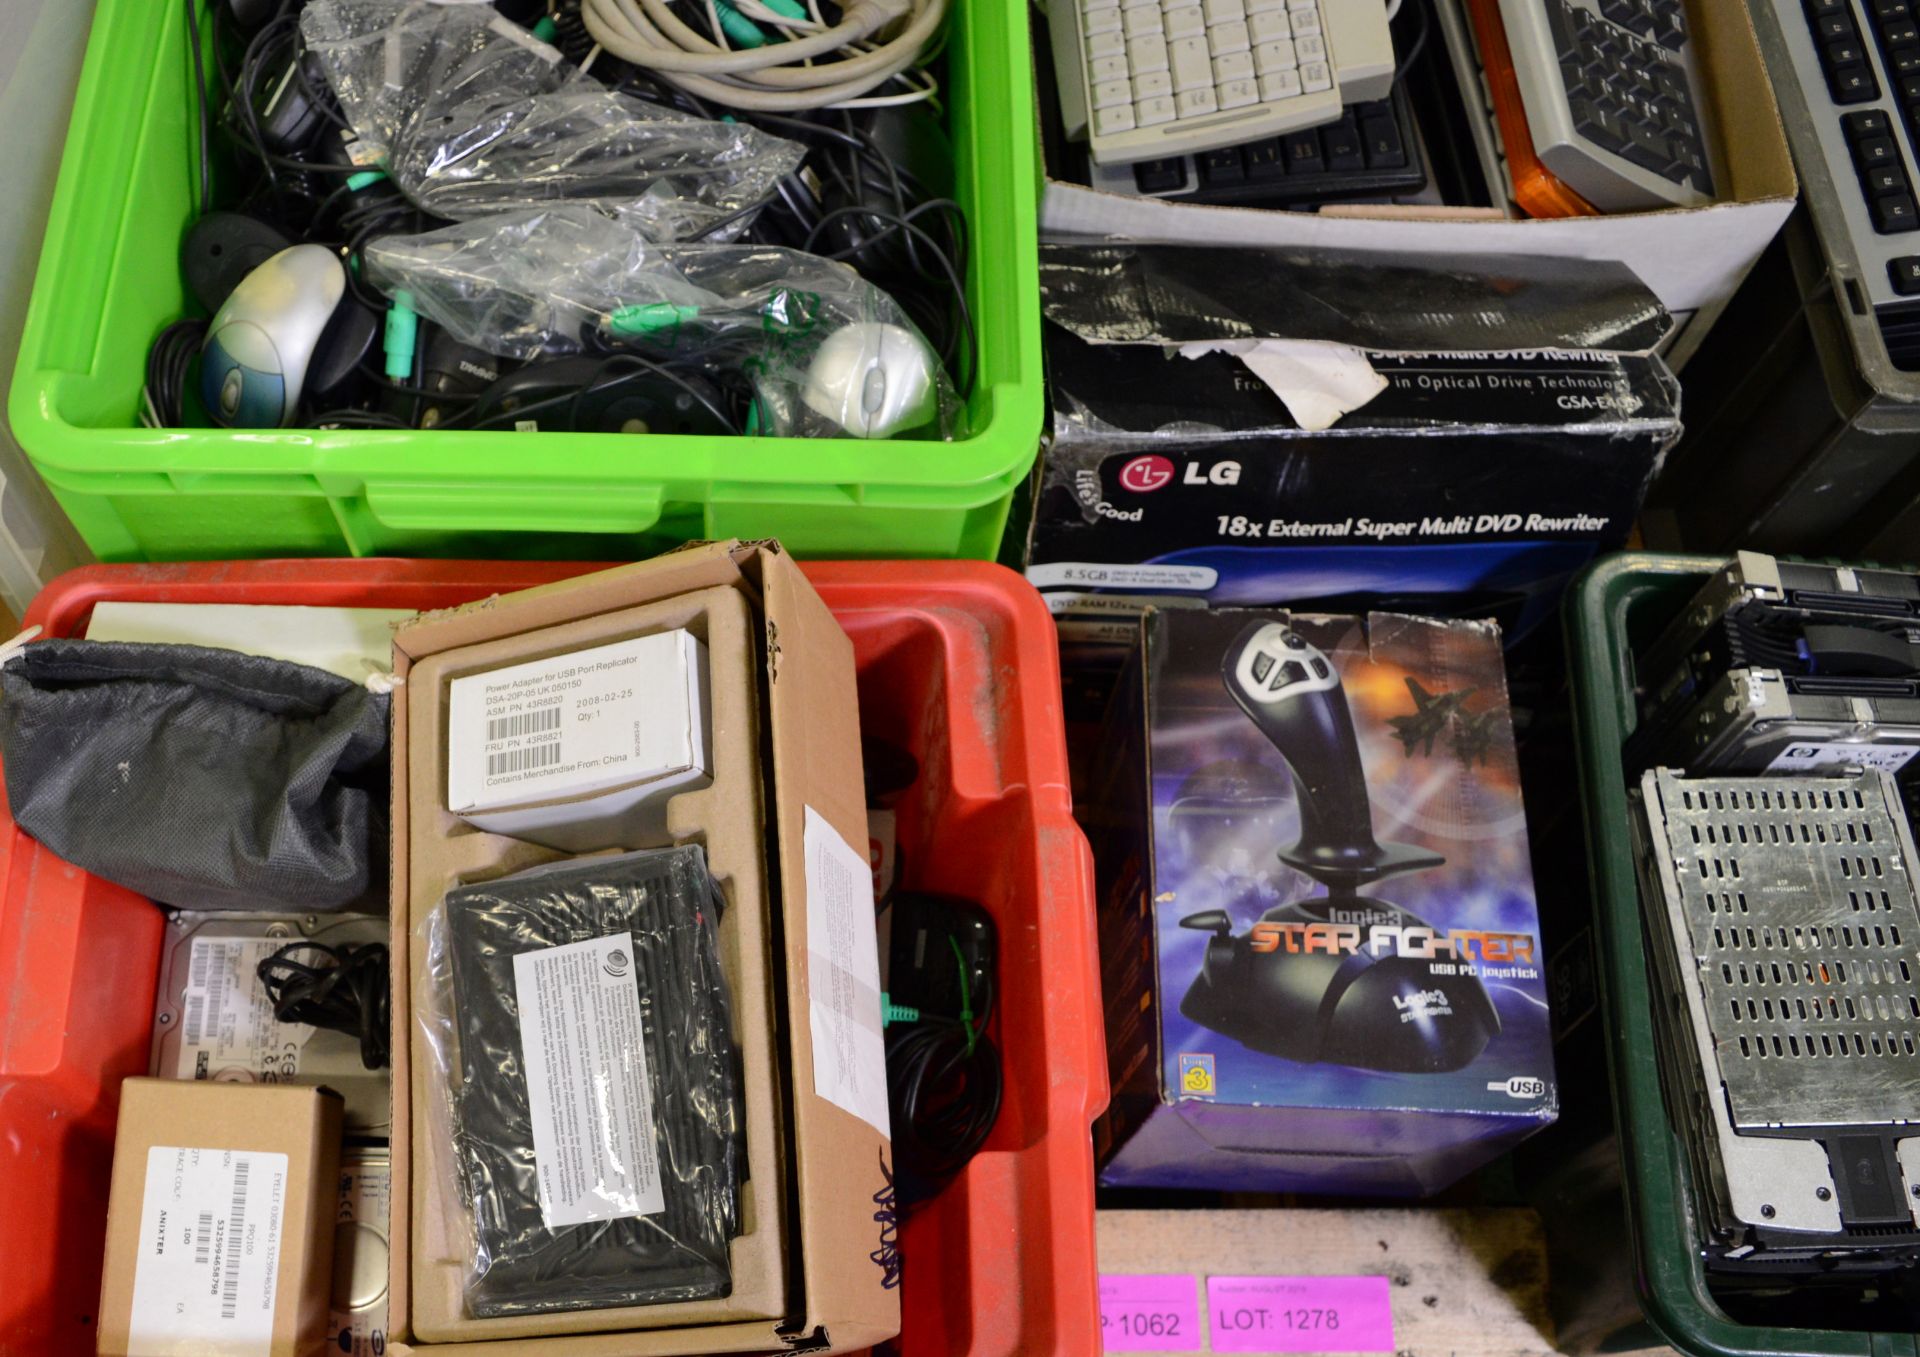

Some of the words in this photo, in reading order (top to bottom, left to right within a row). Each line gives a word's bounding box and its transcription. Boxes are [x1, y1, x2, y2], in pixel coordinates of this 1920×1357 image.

[1395, 375, 1411, 388] in
[1417, 375, 1482, 391] Optical
[1487, 375, 1533, 389] Drive
[1183, 460, 1242, 485] LG
[1094, 500, 1144, 522] Good
[1216, 515, 1263, 538] 18x
[1267, 518, 1352, 537] External
[1354, 517, 1417, 541] Super
[1419, 515, 1473, 536] Multi
[1475, 514, 1523, 533] DVD
[1525, 513, 1610, 532] Rewriter
[486, 683, 510, 694] Power
[512, 676, 544, 688] Adapter
[544, 673, 556, 682] for
[557, 668, 576, 680] USB
[578, 664, 595, 675] Port
[596, 655, 638, 671] Replicator
[485, 689, 536, 706] DSA-20P-05
[538, 685, 550, 695] UK
[551, 679, 582, 693] 050150
[576, 689, 633, 708] 2008-02-25
[486, 706, 506, 717] ASM
[509, 703, 522, 713] PN
[526, 695, 563, 710] 43R8820
[577, 712, 594, 722] Qty:
[485, 742, 504, 752] FRU
[508, 739, 521, 748] PN
[526, 731, 563, 745] 43R8821
[486, 774, 523, 787] Contains
[523, 764, 576, 780] Merchandise
[577, 760, 601, 770] From:
[602, 754, 628, 765] China
[1251, 921, 1361, 956] STAR
[1369, 925, 1535, 964] FIGHTER
[1429, 963, 1457, 975] USB
[1459, 964, 1479, 976] PC
[1482, 965, 1538, 980] joystick
[1187, 1066, 1208, 1091] 3
[1510, 1080, 1544, 1094] USB
[156, 1209, 168, 1255] ANIXTER
[184, 1227, 192, 1245] 100
[210, 1219, 225, 1295] 5325994658798
[176, 1302, 184, 1314] EA
[1219, 1308, 1274, 1331] LOT:
[1283, 1308, 1340, 1330] 1278
[1118, 1313, 1181, 1337] 1062
